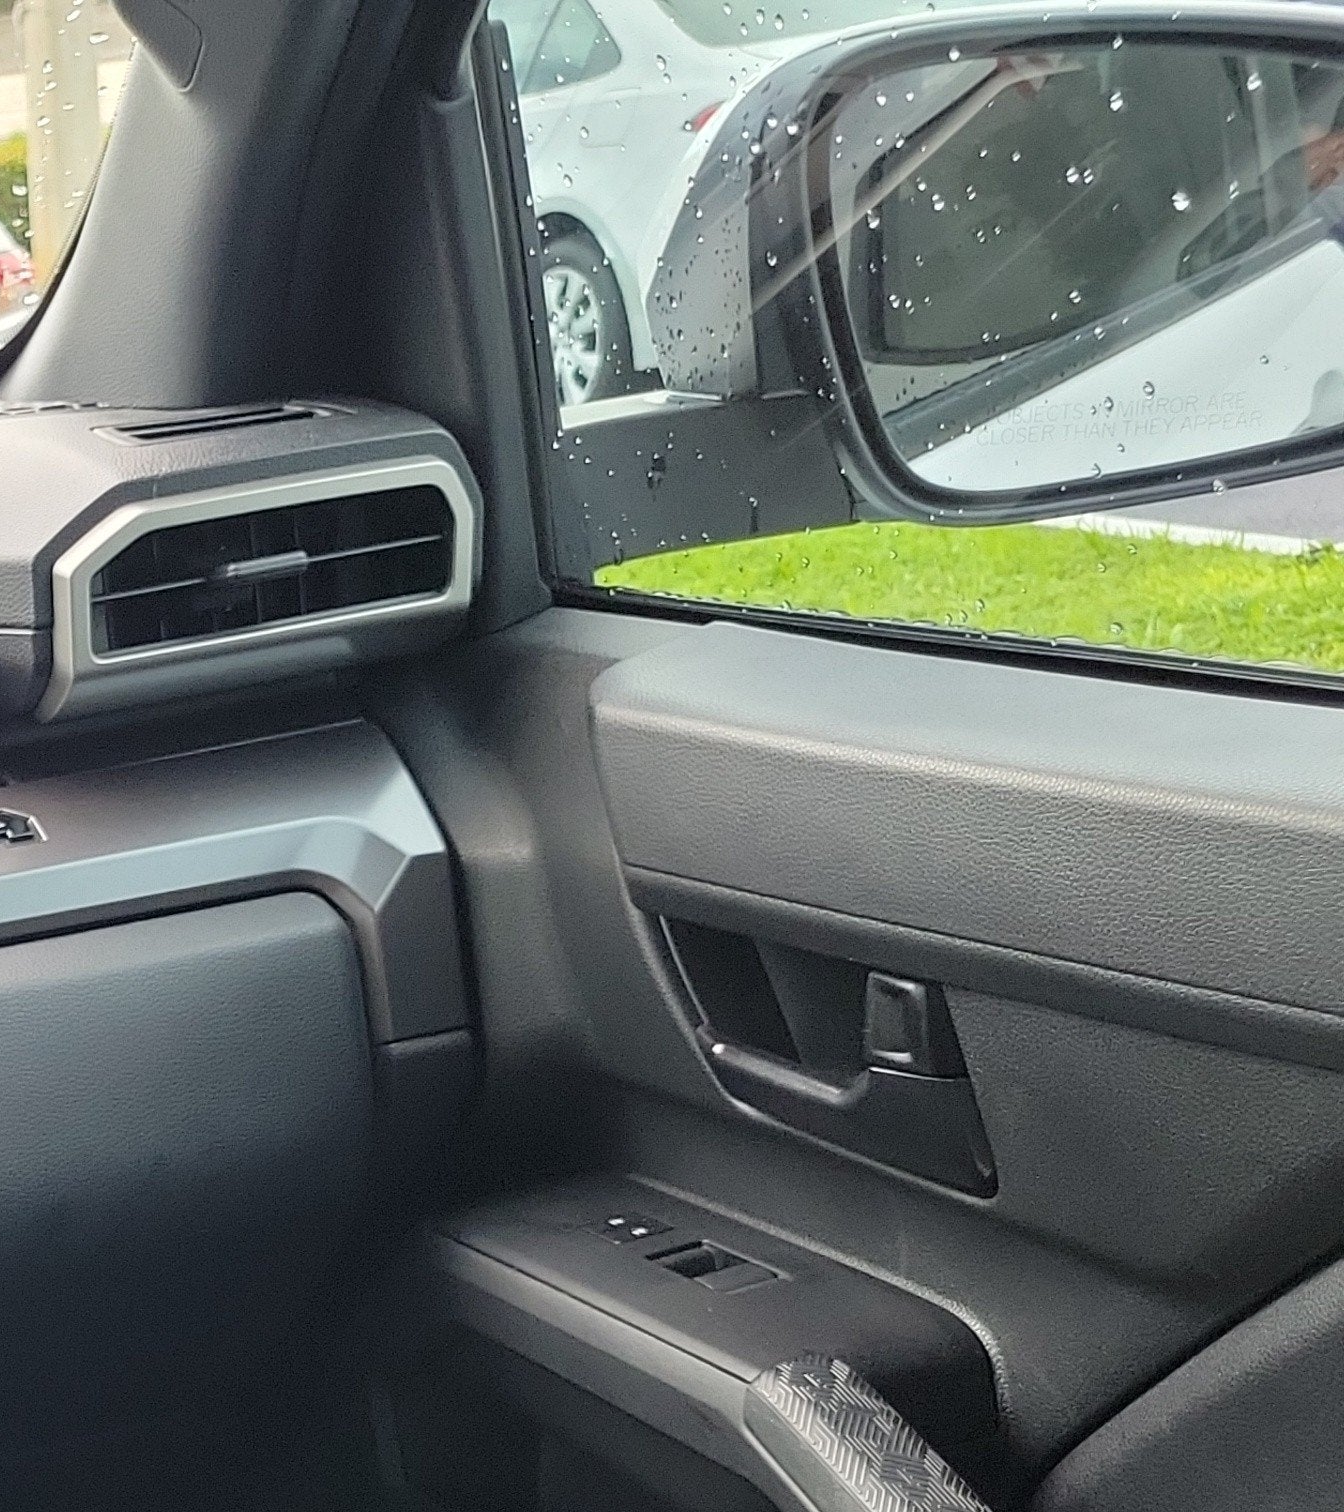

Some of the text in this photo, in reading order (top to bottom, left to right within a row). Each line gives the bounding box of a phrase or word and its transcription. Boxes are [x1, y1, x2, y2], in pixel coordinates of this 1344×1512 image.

[997, 402, 1083, 424] OBJECTS
[1116, 395, 1198, 417] MIRROR
[1206, 391, 1247, 410] ARE
[976, 410, 1263, 447] CLOSER THAN THEY APPEAR
